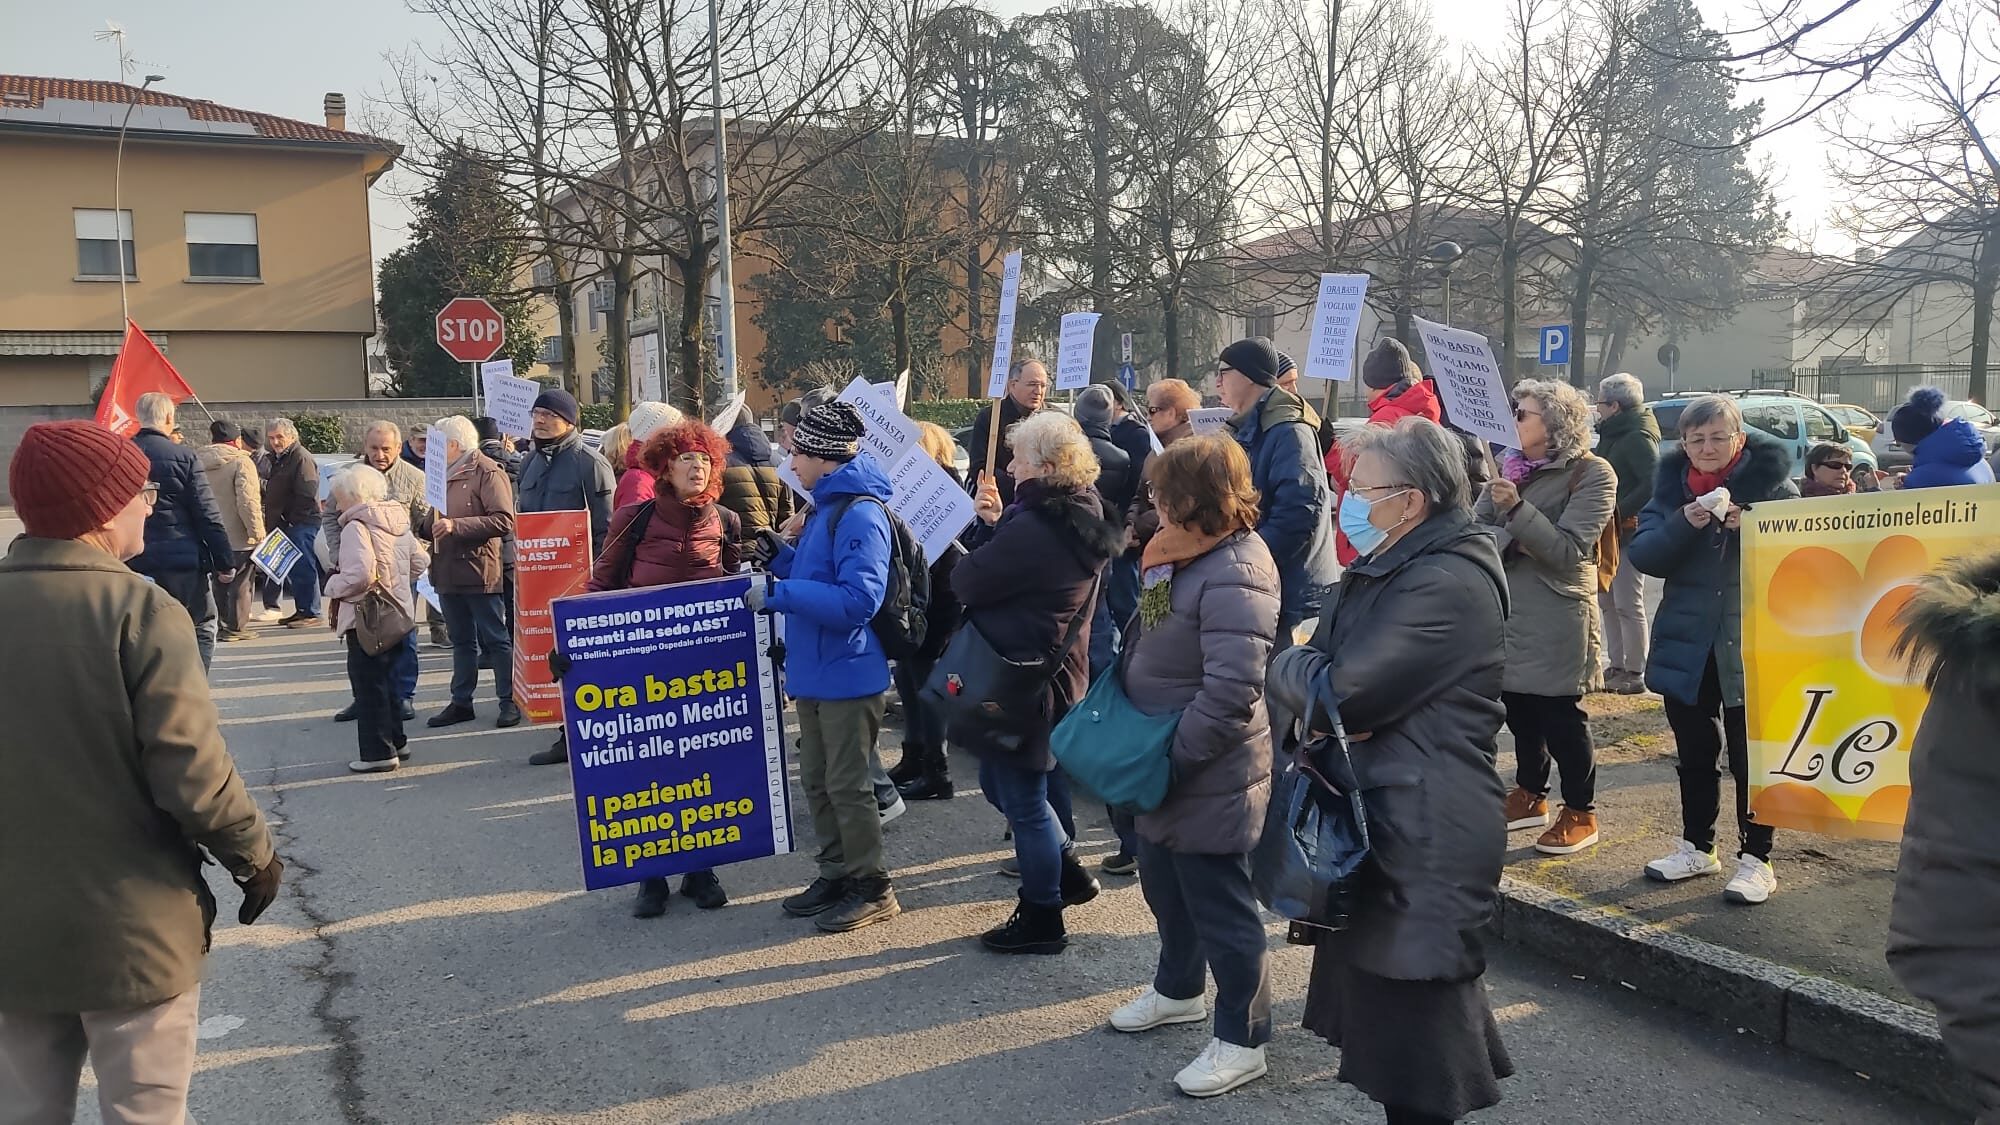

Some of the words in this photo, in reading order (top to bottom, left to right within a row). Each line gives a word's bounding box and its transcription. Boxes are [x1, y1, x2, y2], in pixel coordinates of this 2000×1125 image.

[1326, 286, 1340, 294] ORA
[1342, 286, 1358, 294] BASTA
[1323, 302, 1356, 310] VOGLIAMO
[1325, 316, 1350, 324] MEDICO
[442, 318, 499, 342] STOP
[1324, 327, 1332, 335] DI
[1426, 333, 1447, 346] ORA
[1448, 341, 1483, 356] BASTA
[1546, 330, 1564, 360] P
[1322, 347, 1343, 355] VICINO
[1432, 350, 1490, 373] VOGLIAMO
[1444, 367, 1486, 386] MEDICO
[1461, 387, 1489, 398] BASE
[854, 396, 876, 417] ORA
[876, 415, 905, 443] BASTA
[891, 456, 917, 486] RATORI
[893, 470, 933, 514] AVORATRICI
[900, 484, 908, 492] E
[918, 501, 956, 543] CERTIFICATI
[920, 505, 942, 528] SENZA
[1758, 500, 1978, 534] www.associazioneleali.it
[516, 537, 570, 549] ROTESTA
[528, 551, 557, 561] ASST
[575, 523, 584, 573] SALUTE
[538, 563, 572, 571] Gorgonzola
[566, 610, 642, 631] PRESIDIO
[645, 608, 660, 622] DI
[664, 597, 745, 620] PROTESTA
[567, 630, 624, 648] davanti
[627, 627, 653, 642] alla
[656, 623, 690, 637] sede
[692, 617, 730, 633] ASST
[569, 652, 582, 661] Via
[584, 649, 611, 660] Bellini,
[612, 644, 658, 658] parcheggio
[658, 639, 694, 651] Ospedale
[695, 636, 703, 645] di
[704, 631, 746, 644] Gorgonzola
[758, 615, 768, 658] SALU
[575, 684, 637, 712] Ora
[645, 662, 747, 703] basta!
[760, 670, 772, 689] LA
[577, 711, 677, 742] Vogliamo
[682, 693, 748, 725] Medici
[764, 702, 776, 733] PER
[580, 740, 634, 768] vicini
[638, 736, 674, 759] alle
[678, 725, 753, 758] persone
[1769, 690, 1897, 784] Le
[587, 796, 596, 816] I
[604, 773, 712, 820] pazienti
[766, 745, 785, 843] CITTADINI
[589, 812, 674, 842] hanno
[680, 798, 753, 832] perso
[593, 845, 617, 867] la
[624, 825, 740, 868] pazienza
